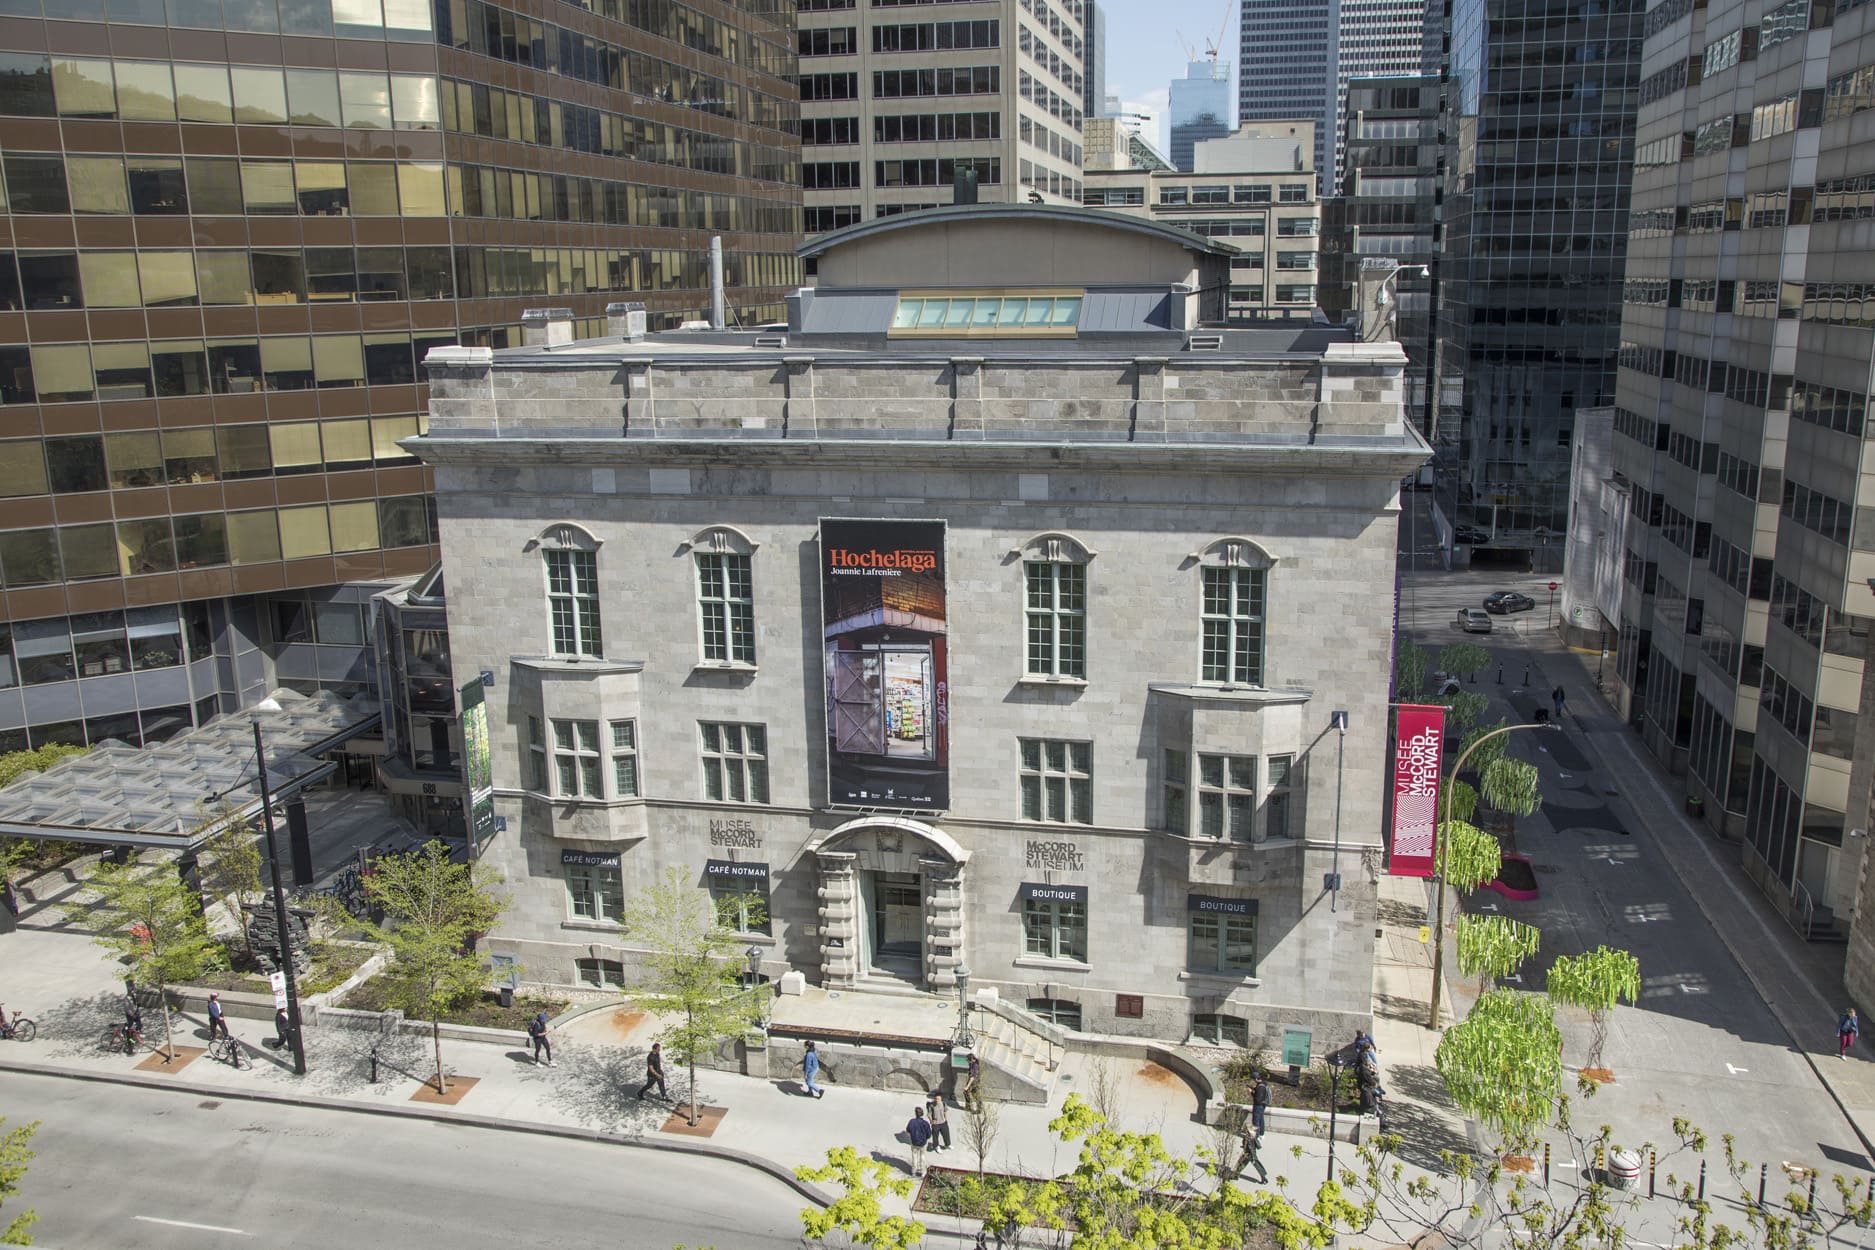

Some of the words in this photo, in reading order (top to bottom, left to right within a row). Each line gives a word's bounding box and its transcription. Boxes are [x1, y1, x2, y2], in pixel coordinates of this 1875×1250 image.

[830, 549, 936, 573] Hochelaga
[830, 567, 861, 576] Joannie
[862, 567, 902, 577] Lafrenière
[1397, 739, 1412, 796] MUSÉE
[1409, 735, 1425, 796] McCORD
[1423, 726, 1440, 798] STEWART
[709, 819, 752, 830] MUSÉE
[710, 828, 756, 840] McCORD
[710, 837, 763, 849] STEWART
[1026, 840, 1076, 853] McCORD
[563, 855, 583, 864] CAFÉ
[585, 856, 618, 866] NOTMAN
[1025, 850, 1083, 863] STEWART
[708, 865, 729, 875] CAFÉ
[731, 867, 766, 877] NOTMAN
[1026, 859, 1084, 871] MUSEUM
[1032, 889, 1077, 900] BOUTIQUE
[1200, 901, 1246, 912] BOUTIQUE
